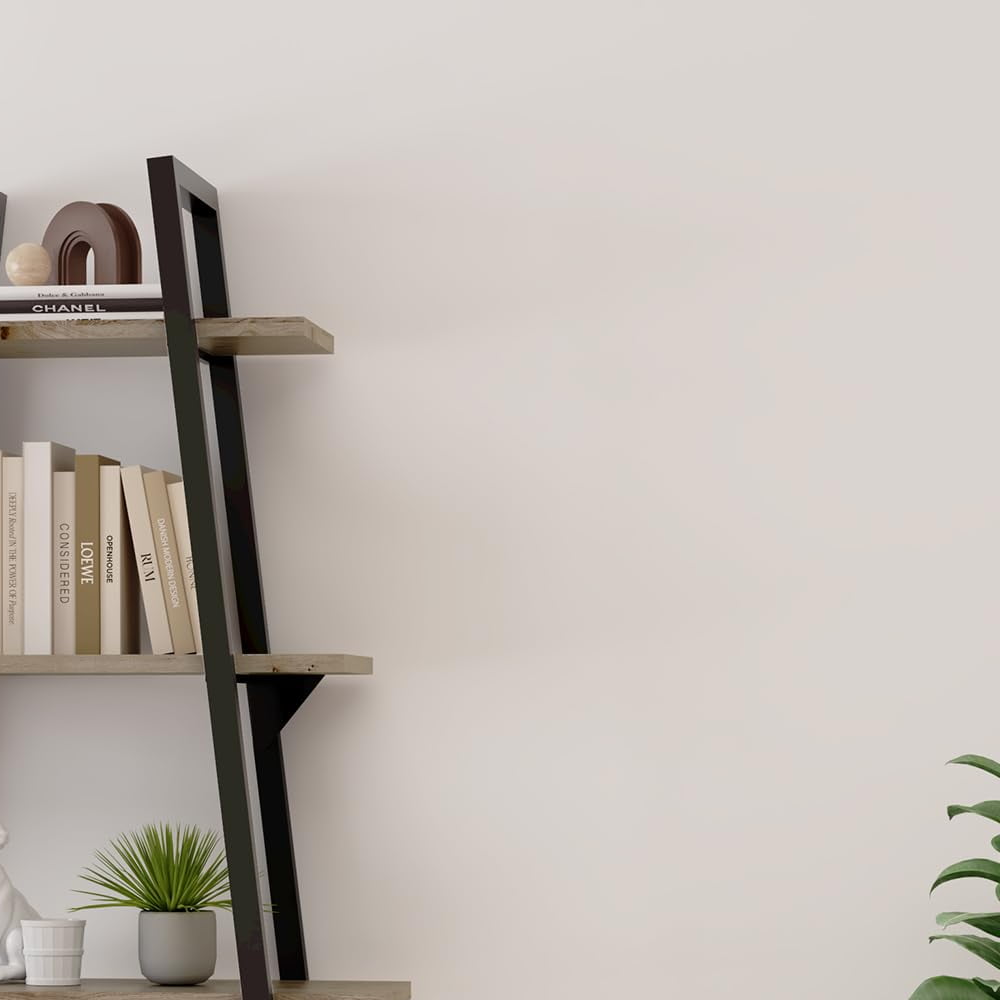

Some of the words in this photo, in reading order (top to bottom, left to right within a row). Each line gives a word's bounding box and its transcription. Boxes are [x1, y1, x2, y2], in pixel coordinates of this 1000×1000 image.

[31, 304, 107, 313] CHANEL
[8, 492, 16, 517] DEEPLY
[157, 518, 169, 547] DANISH
[8, 549, 16, 562] THE
[59, 523, 70, 604] CONSIDERED
[80, 542, 94, 585] LOEWE
[141, 552, 156, 583] RUM
[160, 547, 174, 580] MODERN
[8, 564, 16, 588] POWER
[8, 589, 16, 599] OF
[168, 581, 181, 608] DESIGN
